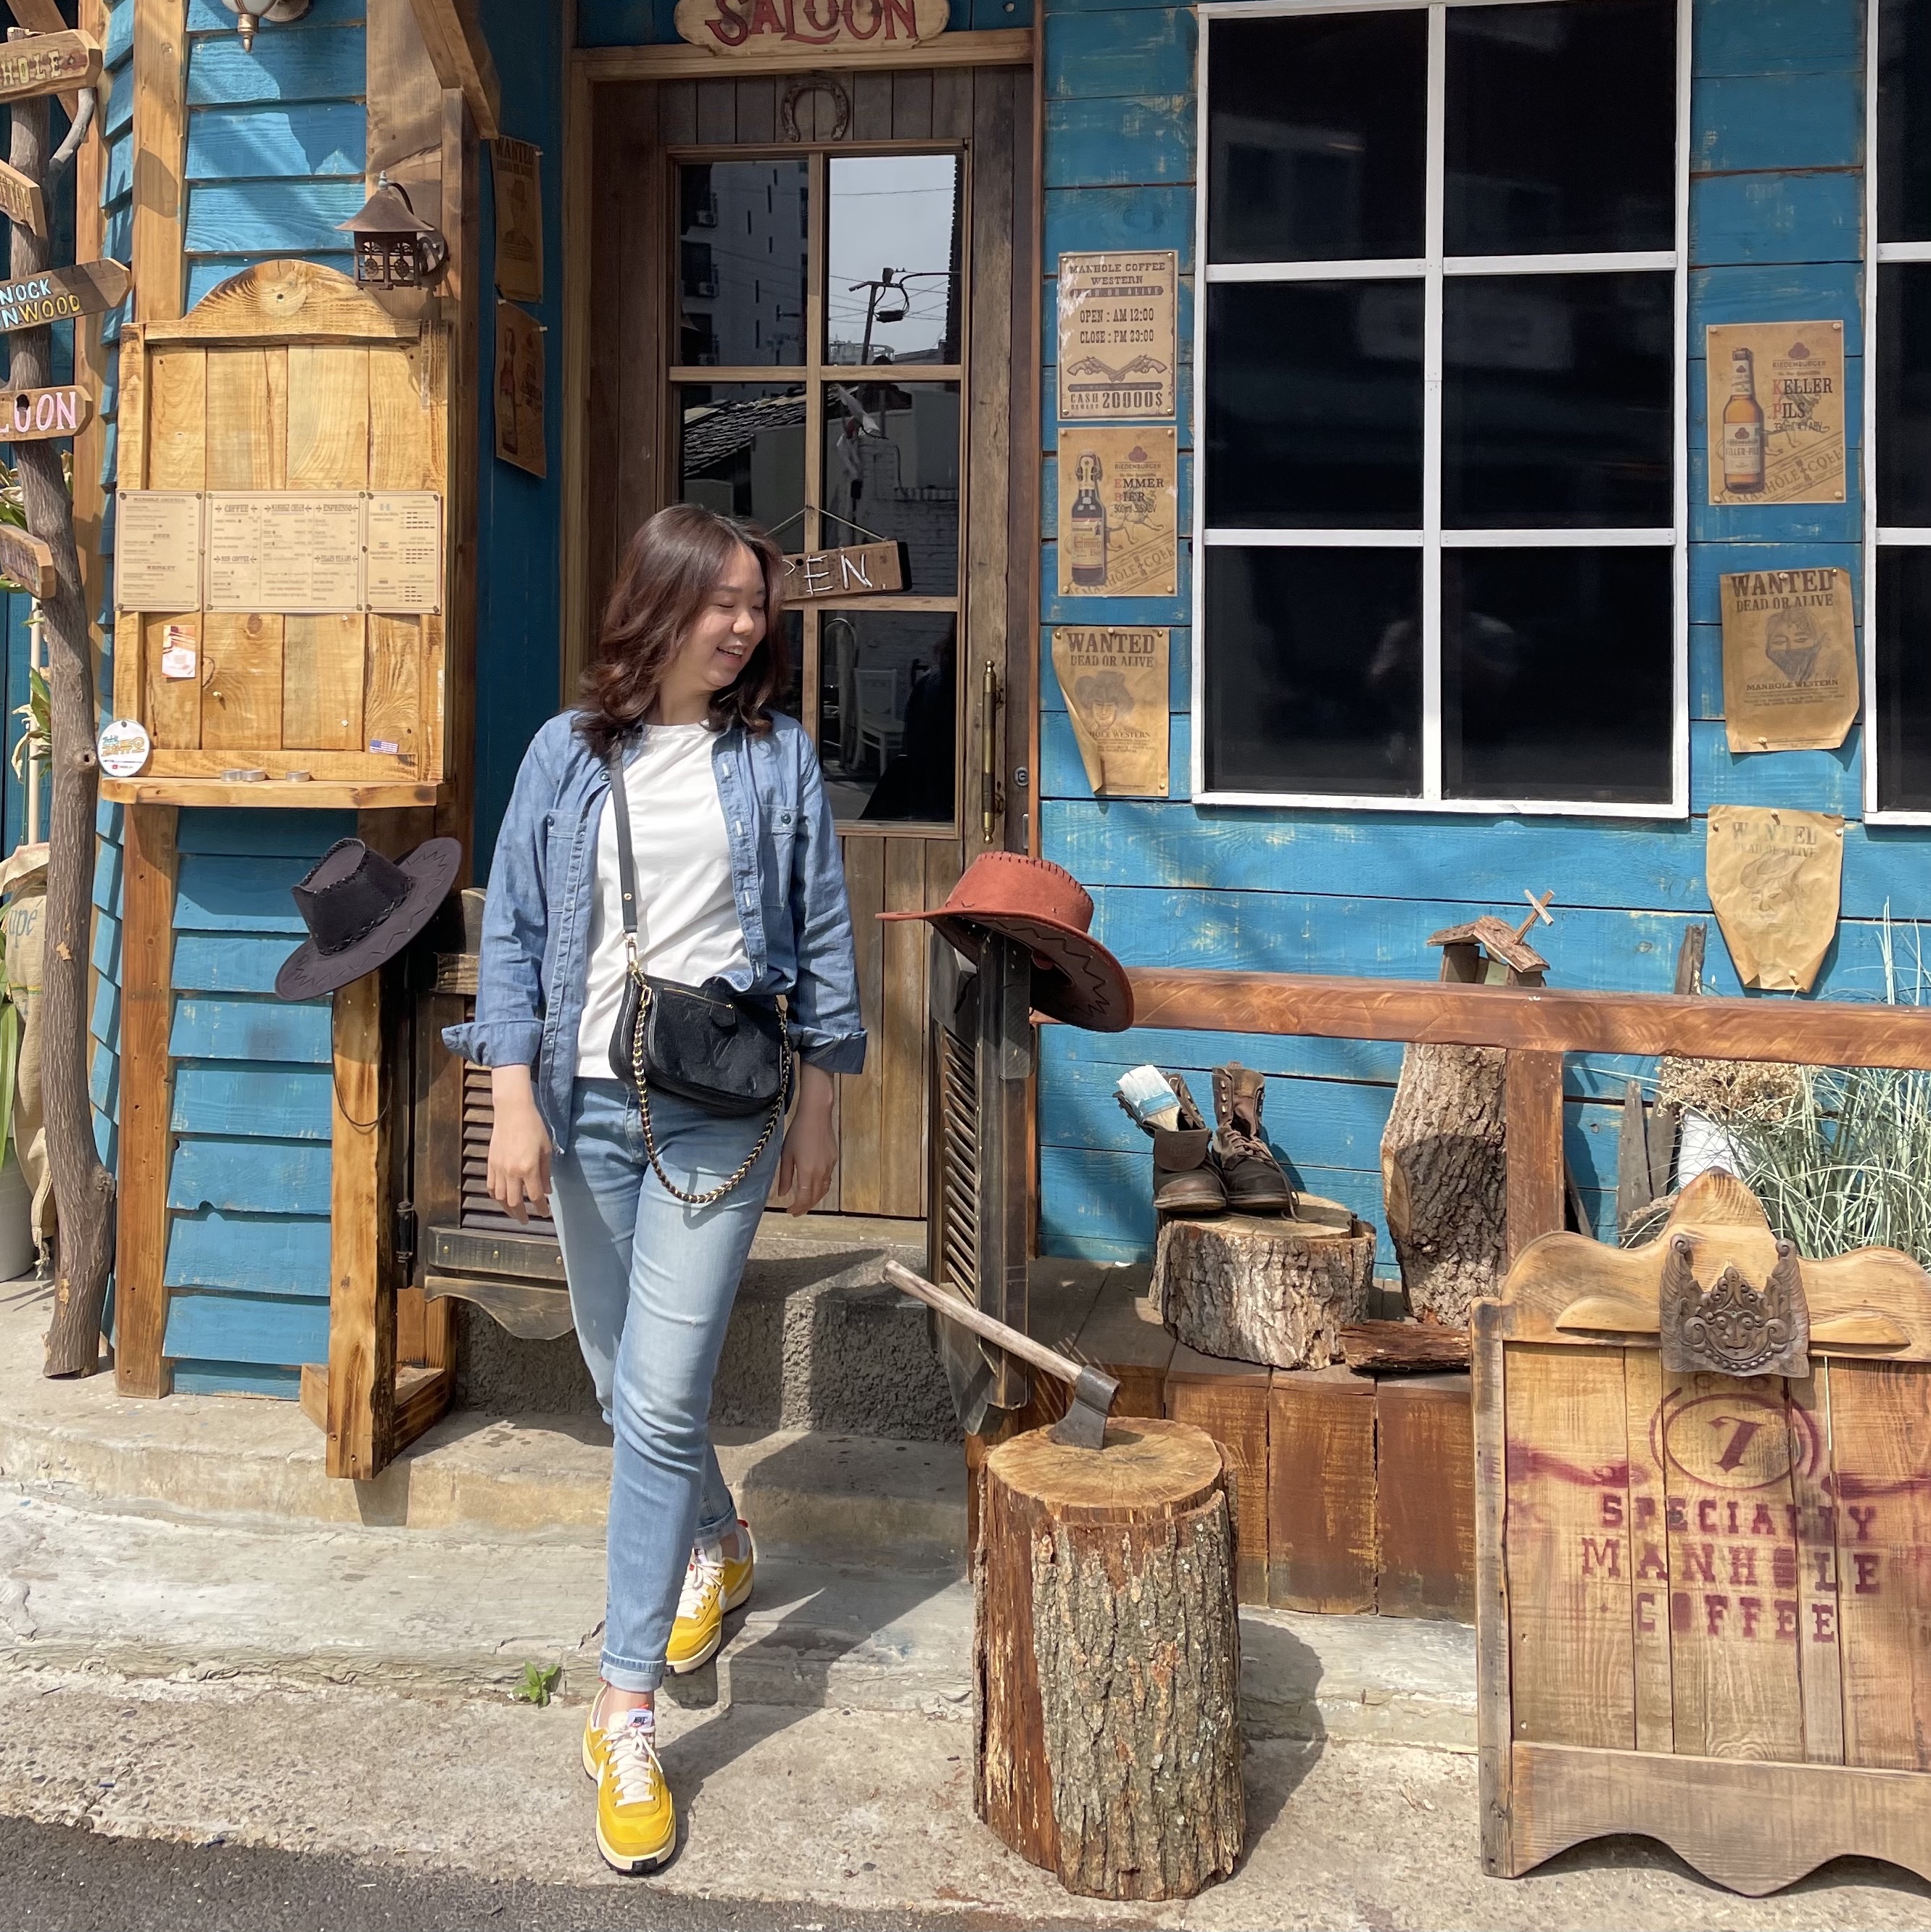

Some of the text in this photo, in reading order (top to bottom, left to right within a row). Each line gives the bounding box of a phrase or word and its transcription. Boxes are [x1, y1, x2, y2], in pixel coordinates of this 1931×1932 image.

[705, 0, 918, 46] SALOON
[1125, 262, 1166, 272] COFFEE
[1091, 275, 1144, 285] WESTERN
[1073, 289, 1101, 298] DAD
[1127, 286, 1159, 296] ALIVE
[1080, 308, 1104, 323] OPEN
[1112, 309, 1128, 322] AM
[1130, 307, 1154, 322] 12:00
[1080, 330, 1106, 344] CLOSE
[1114, 330, 1128, 343] PM
[1130, 329, 1154, 343] 23:00
[1772, 378, 1833, 395] KELLER
[1070, 393, 1099, 404] CASH
[1772, 402, 1806, 420] PILS
[1114, 478, 1165, 488] EMMER
[1114, 492, 1146, 502] BIER
[1730, 570, 1837, 597] WANTED
[1736, 594, 1833, 613] DEAD OR ALIVE
[1066, 632, 1156, 654] WANTED
[1070, 655, 1154, 668] DEAD OR ALIVE
[1746, 681, 1794, 690] MANHOLE
